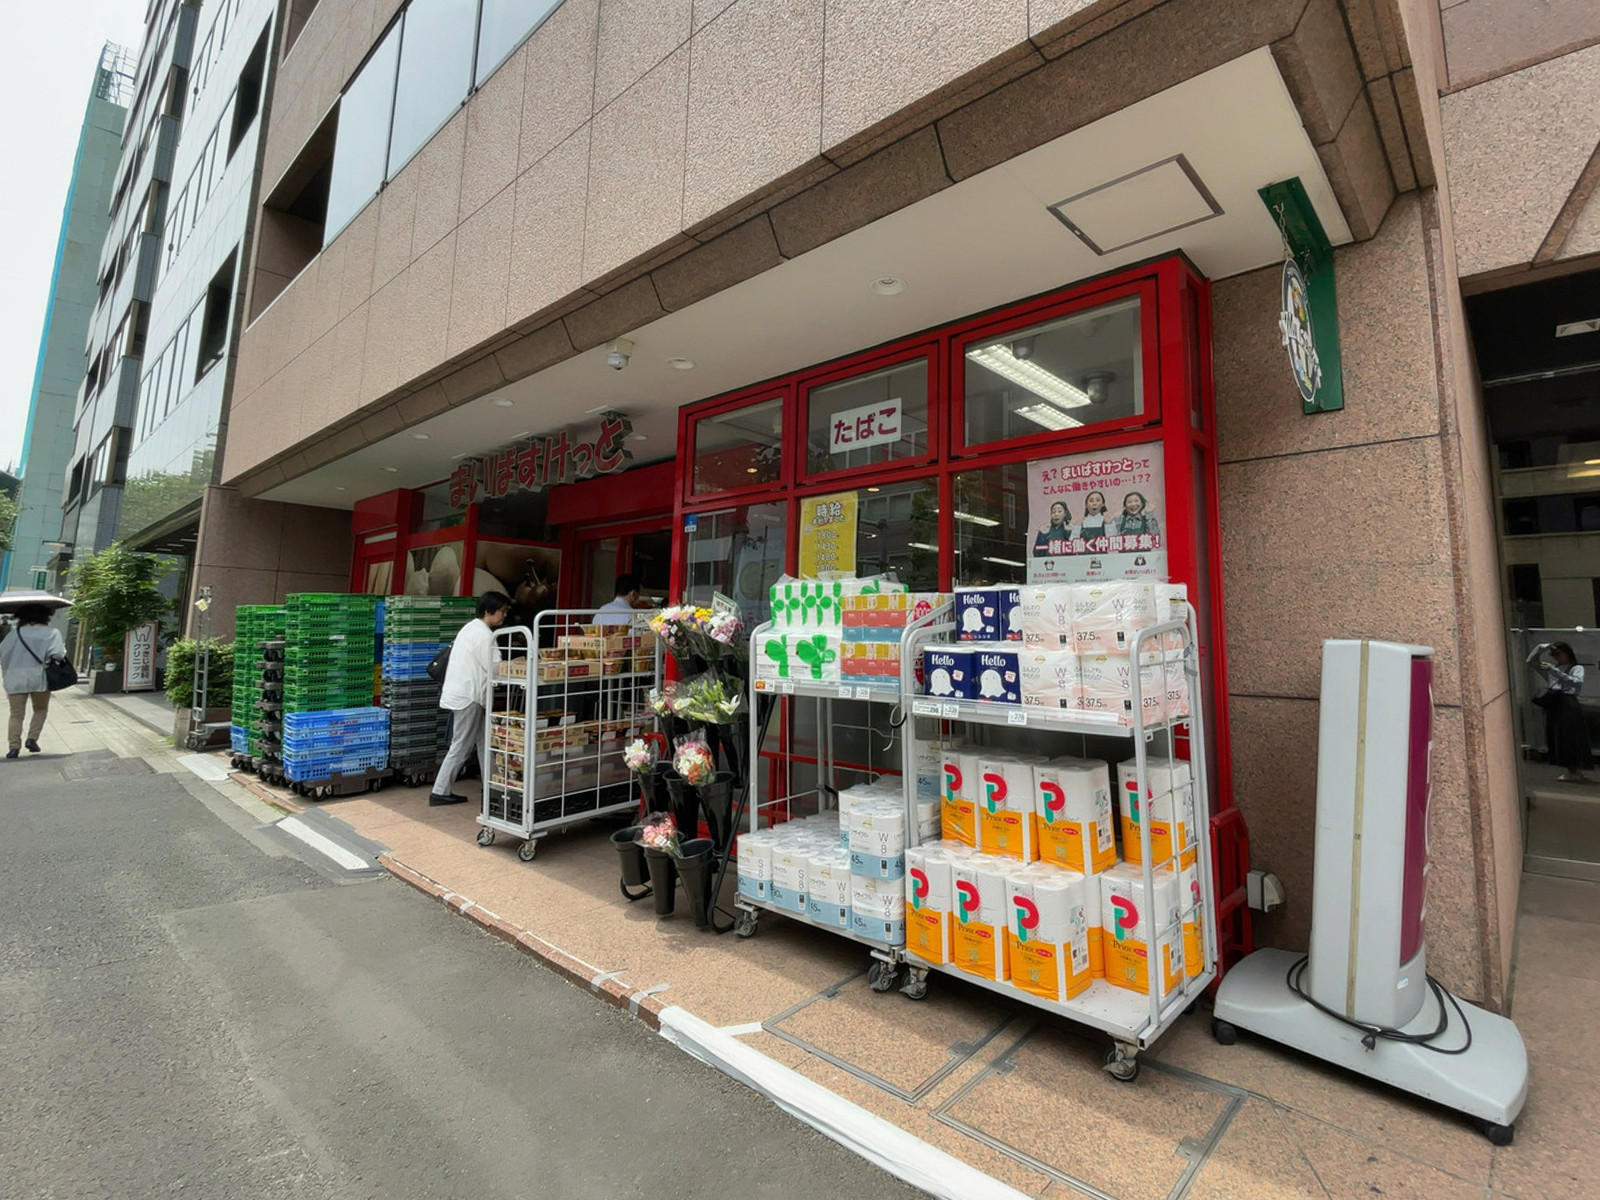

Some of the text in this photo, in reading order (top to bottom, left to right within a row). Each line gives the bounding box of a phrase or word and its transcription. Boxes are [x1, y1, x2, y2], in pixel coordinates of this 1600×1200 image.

[834, 407, 898, 445] たばこ
[449, 416, 625, 508] まいばすけっと
[1042, 469, 1057, 483] え？
[1035, 534, 1161, 554] 一緒に働く仲間募集！
[963, 594, 985, 605] Hello
[1112, 599, 1124, 610] W
[1054, 603, 1067, 613] W
[1058, 615, 1066, 625] 8
[132, 643, 142, 680] クリニック
[931, 654, 955, 666] Hello
[981, 655, 1006, 667] Hello
[1054, 667, 1067, 678] W
[1117, 666, 1129, 677] W
[1121, 680, 1130, 689] 8
[878, 832, 889, 842] W
[880, 844, 887, 854] 8
[757, 858, 764, 868] S
[798, 869, 805, 879] S
[798, 880, 805, 889] 8
[837, 881, 847, 891] W
[839, 893, 845, 903] 8
[882, 895, 893, 905] W
[883, 908, 891, 917] 8
[1016, 941, 1035, 953] Prior
[1113, 941, 1132, 953] Prior
